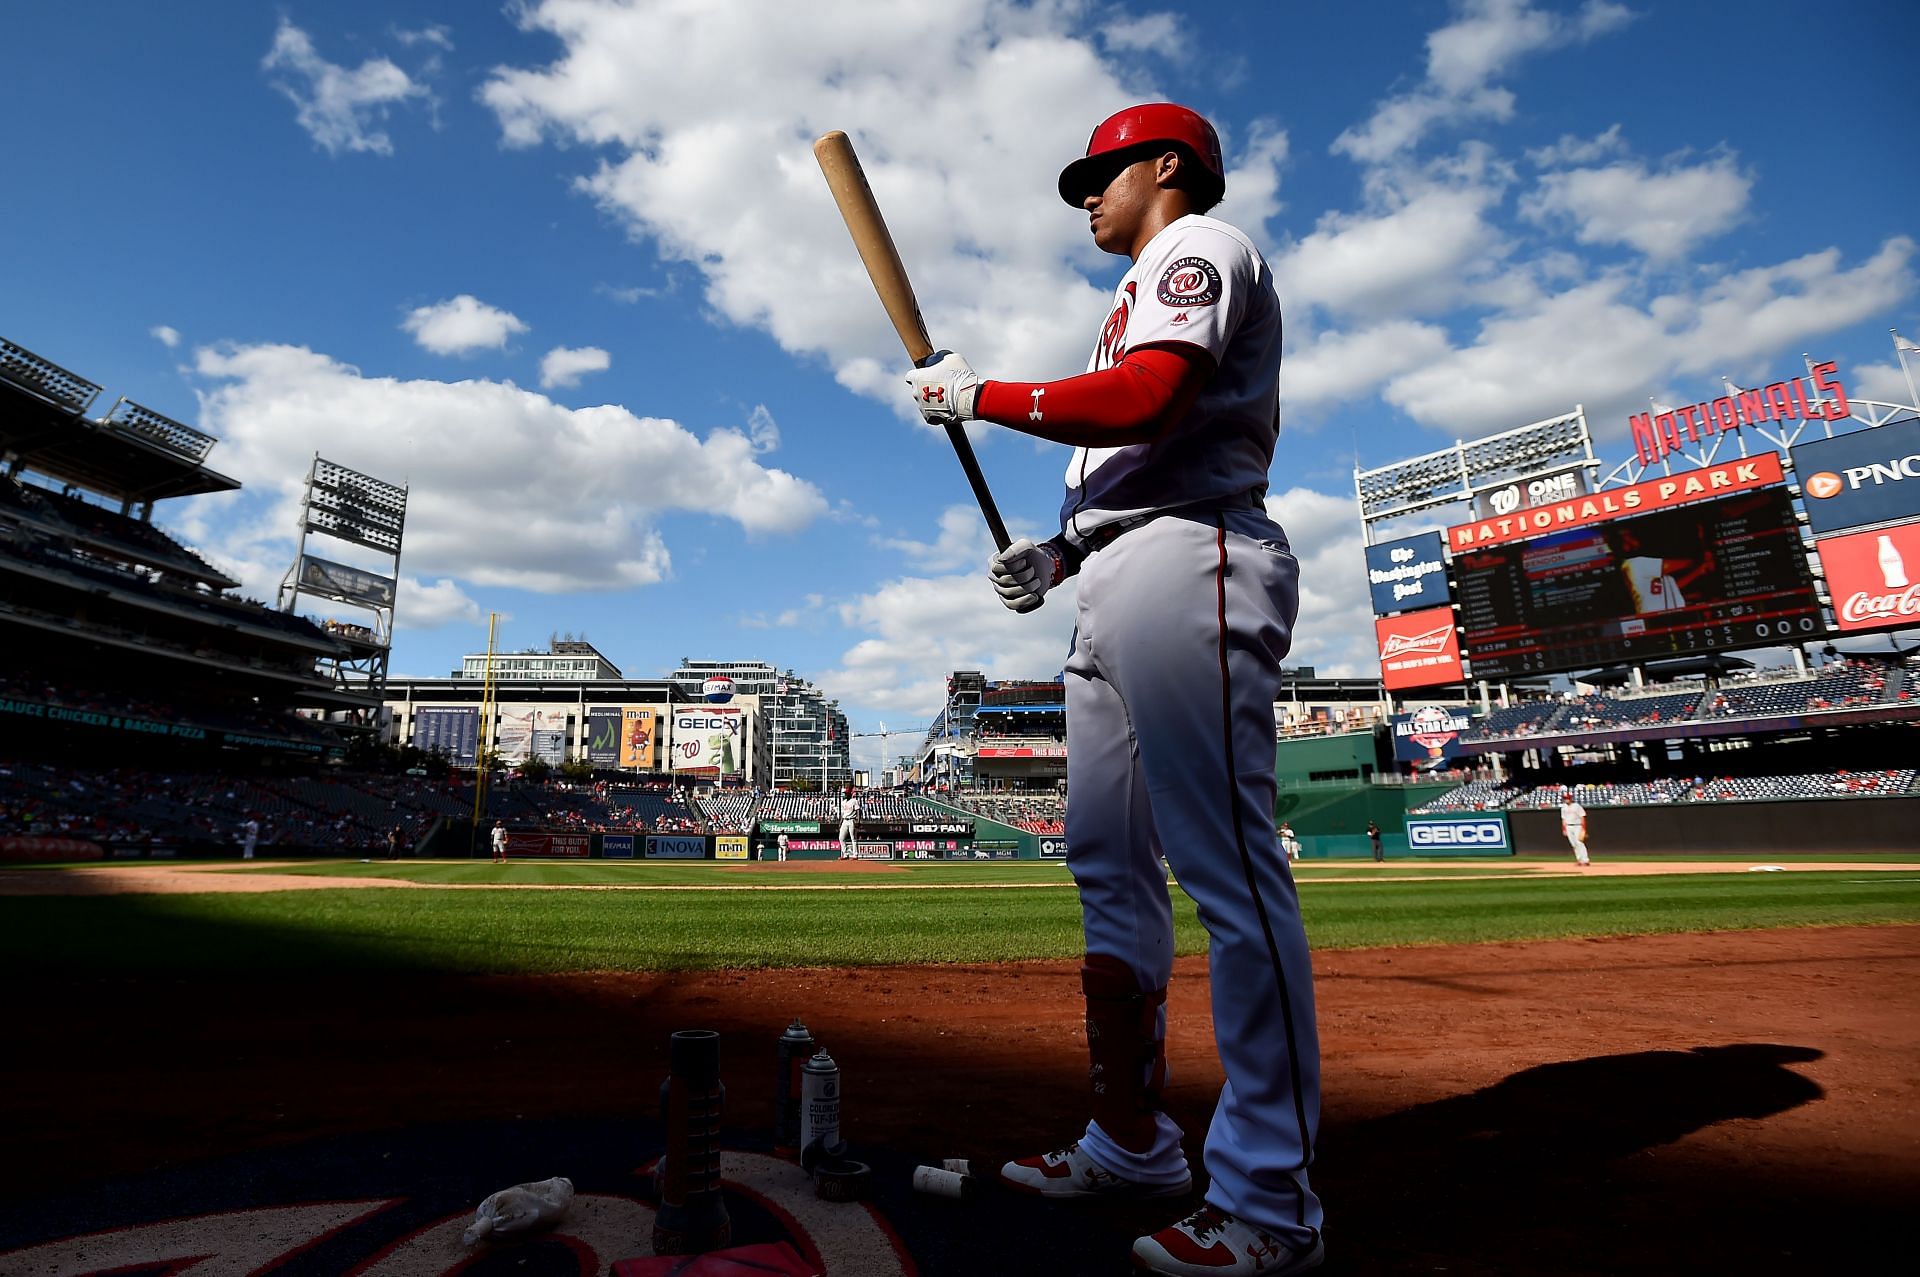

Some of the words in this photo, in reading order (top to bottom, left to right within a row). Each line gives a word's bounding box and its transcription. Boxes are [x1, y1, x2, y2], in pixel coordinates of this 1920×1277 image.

[1162, 258, 1218, 280] WASHINGTON
[1161, 292, 1213, 304] NATIONALS
[1629, 361, 1851, 467] NATIONALS
[1842, 454, 1920, 489] PNC
[1528, 473, 1576, 497] ONE
[1457, 490, 1641, 546] NATIONALS
[1659, 463, 1761, 500] PARK
[1370, 561, 1443, 584] Washington
[1393, 580, 1423, 601] Post
[1650, 578, 1662, 595] 6
[1755, 623, 1770, 637] 0
[1776, 620, 1791, 635] 0
[1799, 617, 1814, 631] 0
[47, 706, 109, 727] CHICKEN
[171, 725, 206, 739] PIZZA
[679, 718, 738, 729] GEICO
[1396, 722, 1415, 736] ALL
[1415, 720, 1441, 734] STAR
[1441, 717, 1470, 732] GAME
[552, 837, 566, 845] THIS
[1413, 825, 1501, 844] GEICO
[604, 842, 631, 850] RE/MAX
[660, 841, 704, 853] INOVA
